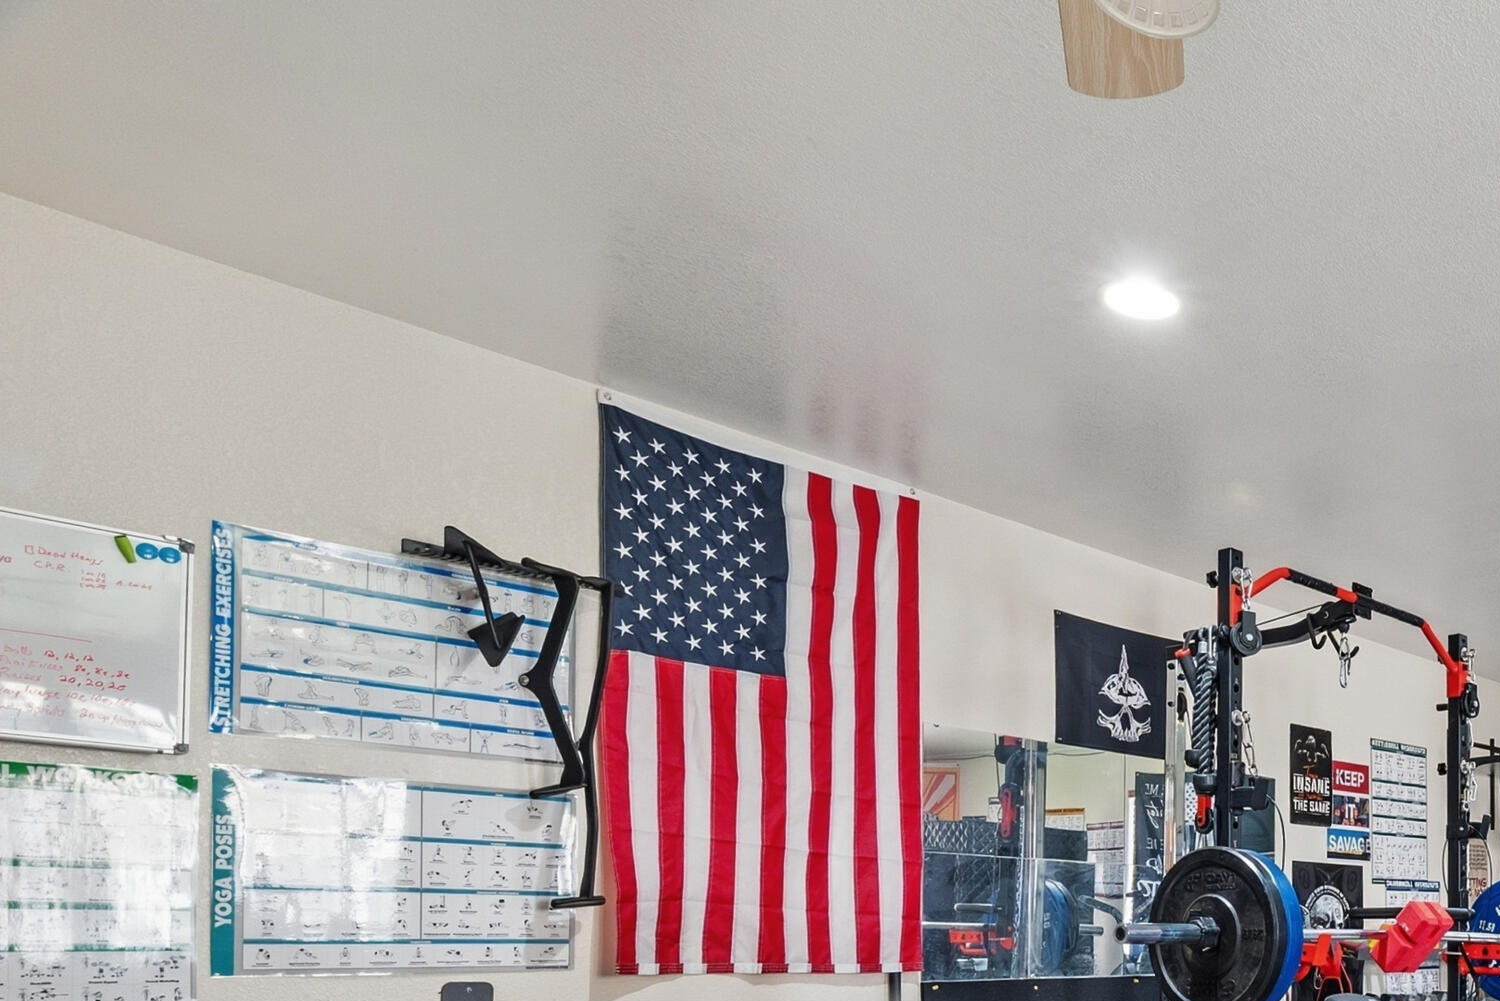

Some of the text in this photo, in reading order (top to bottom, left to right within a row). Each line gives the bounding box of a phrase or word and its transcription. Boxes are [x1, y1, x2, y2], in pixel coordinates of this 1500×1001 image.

[215, 528, 233, 618] EXERCISES
[1293, 774, 1330, 796] INSANE
[1335, 768, 1365, 788] KEEP
[1293, 798, 1331, 814] THE SAME
[1345, 804, 1357, 820] IT
[214, 815, 233, 928] YOGA POSES
